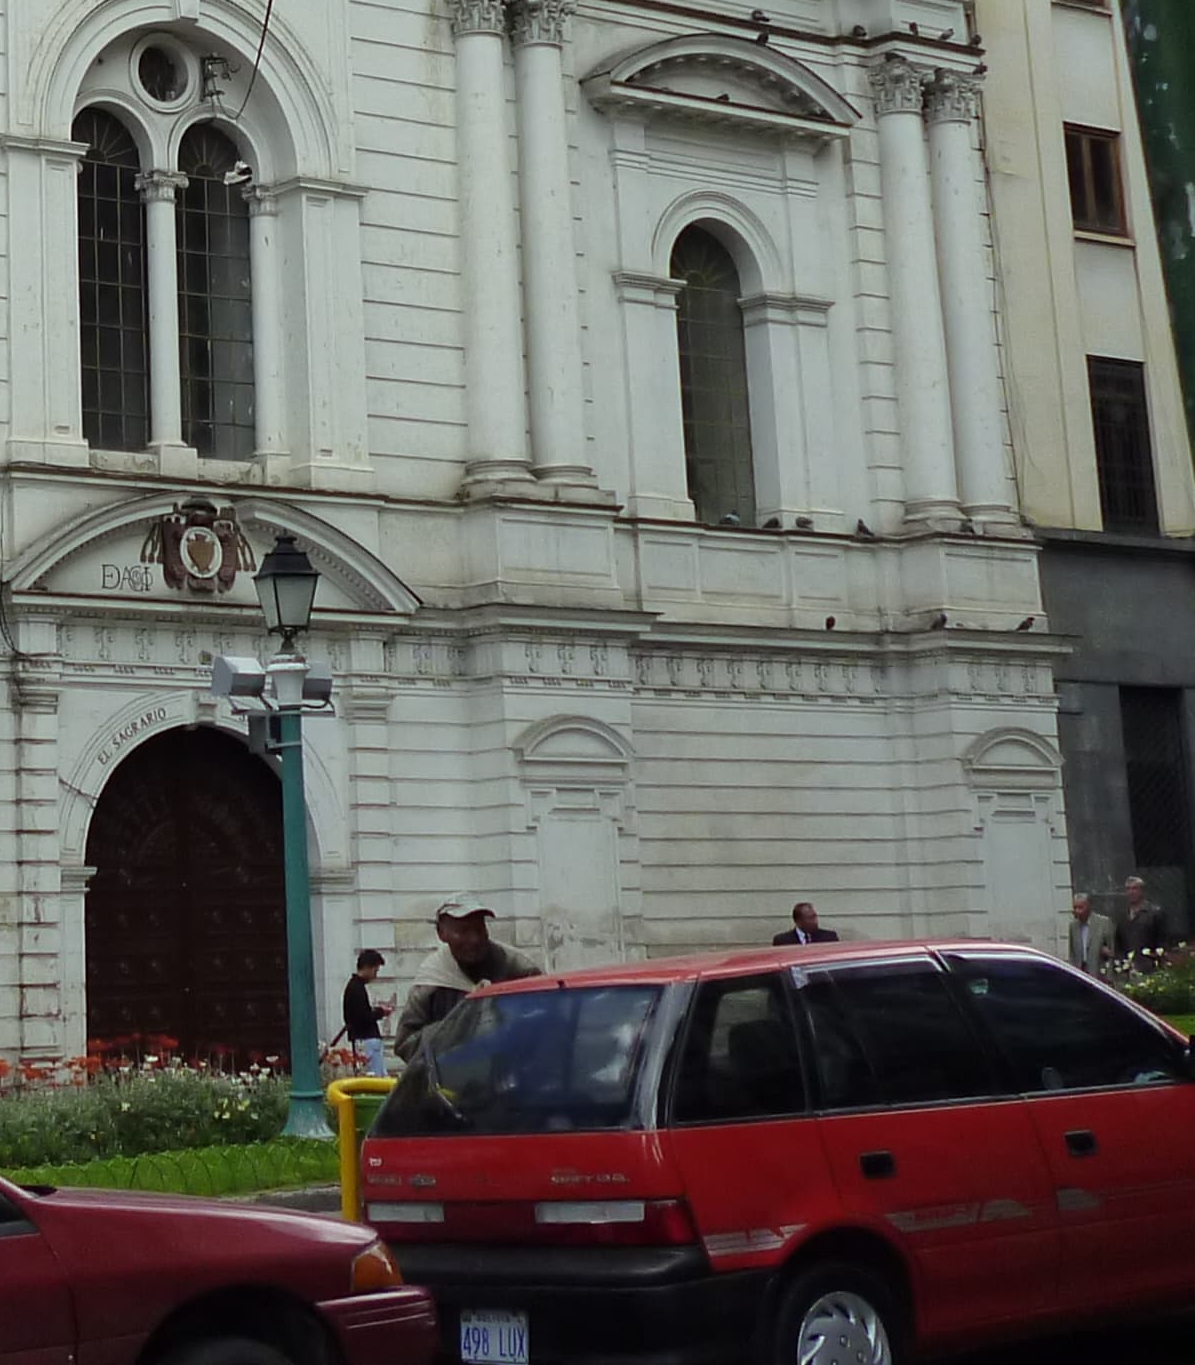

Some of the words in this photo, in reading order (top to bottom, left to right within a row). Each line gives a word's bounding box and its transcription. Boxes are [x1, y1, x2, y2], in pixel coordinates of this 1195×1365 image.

[97, 749, 112, 766] EL
[114, 707, 167, 749] SAGRARIO
[463, 1327, 489, 1356] 498
[499, 1327, 525, 1358] LUX
